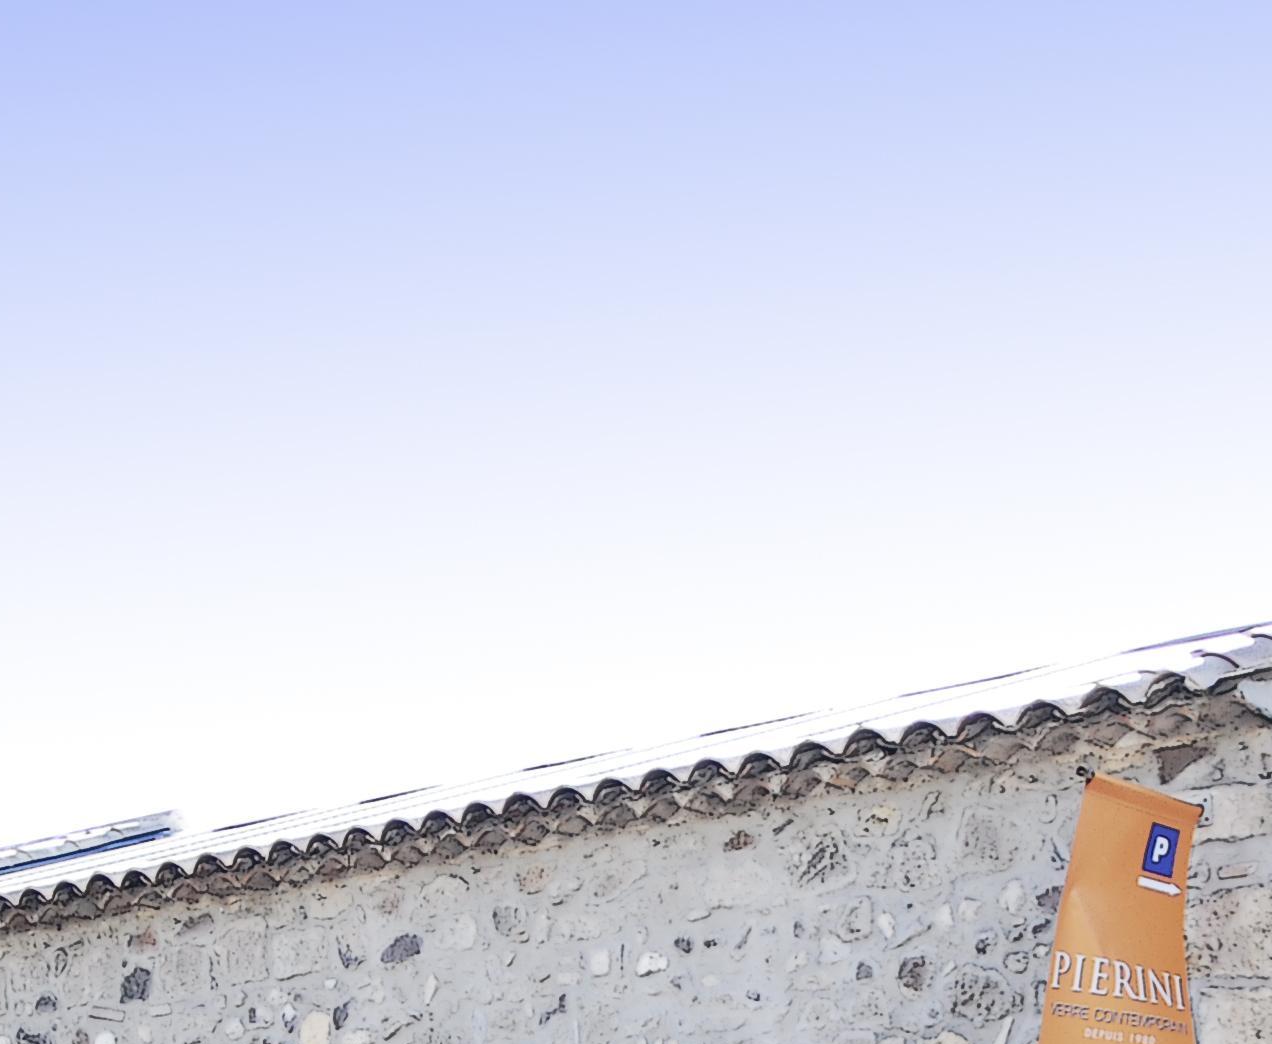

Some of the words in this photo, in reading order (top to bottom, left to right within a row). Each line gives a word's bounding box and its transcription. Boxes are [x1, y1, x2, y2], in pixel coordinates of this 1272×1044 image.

[1152, 836, 1169, 863] P
[1051, 950, 1185, 1011] PIERINI
[1051, 1002, 1090, 1021] VERRE
[1094, 1008, 1189, 1035] CONTEMPORAIN
[1083, 1027, 1124, 1042] DEPUIS
